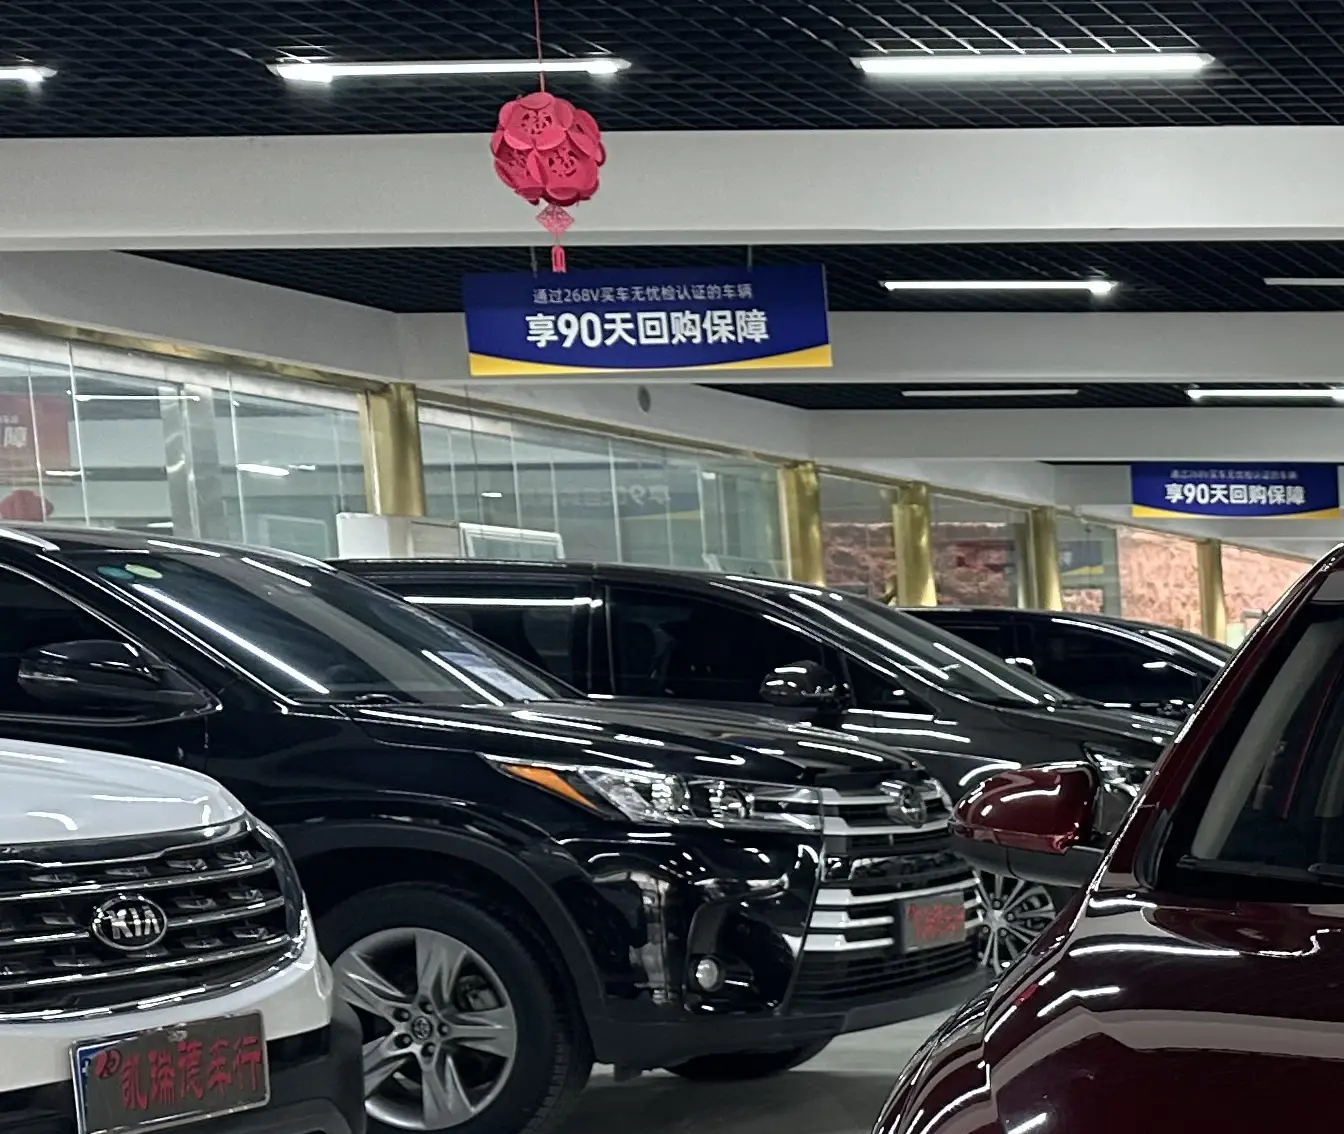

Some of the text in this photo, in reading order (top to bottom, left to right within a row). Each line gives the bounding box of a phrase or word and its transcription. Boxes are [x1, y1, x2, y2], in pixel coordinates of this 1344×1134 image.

[525, 309, 769, 348] 享90天回购保障
[1164, 483, 1305, 505] 享90天回购保障
[107, 907, 160, 939] KIA
